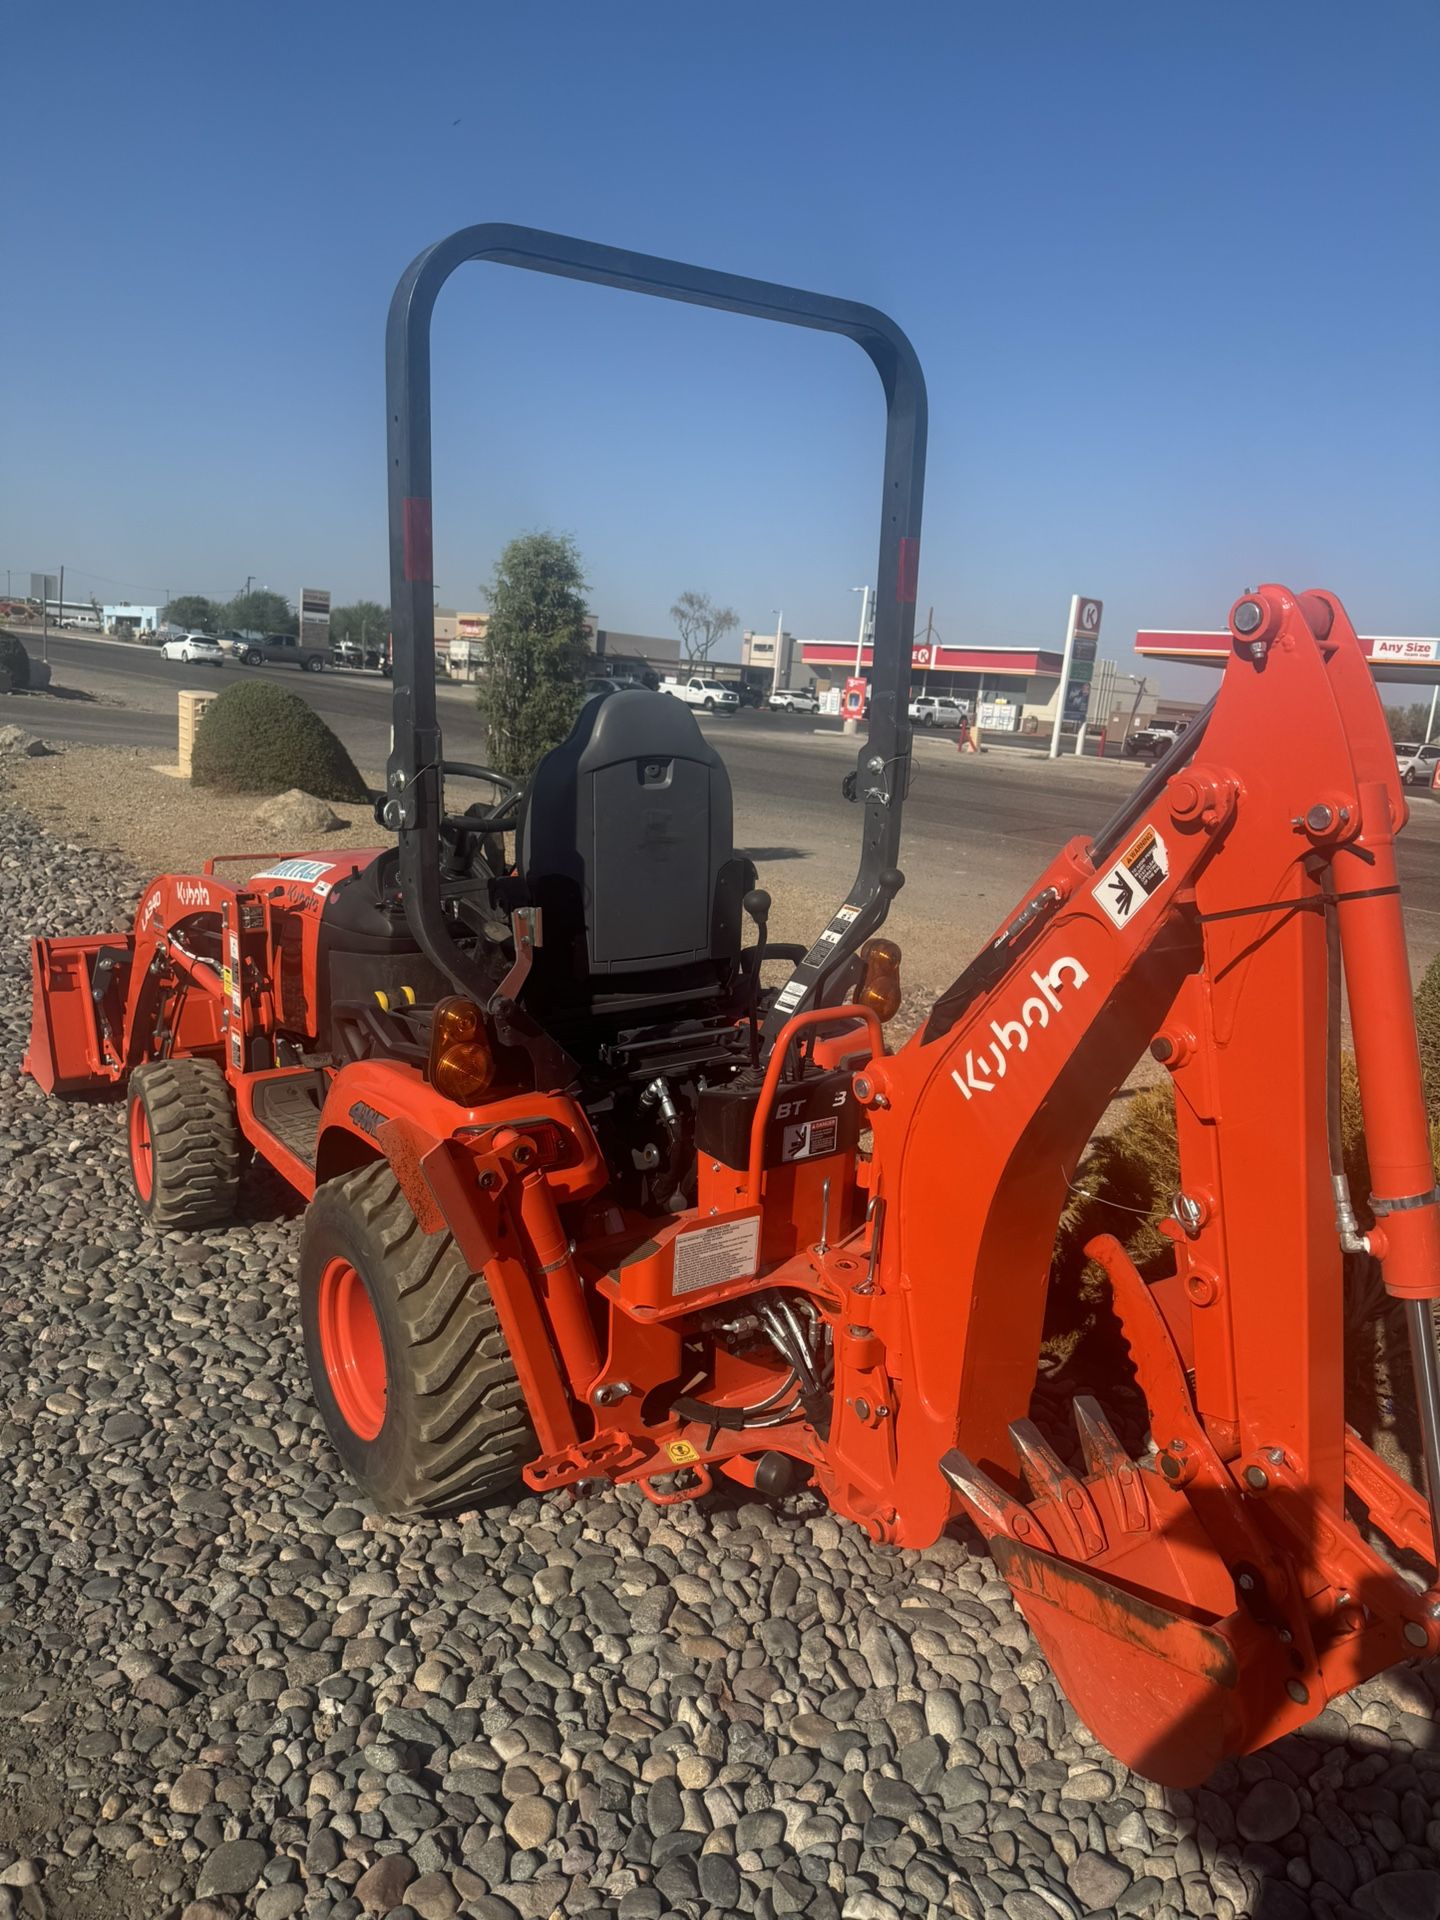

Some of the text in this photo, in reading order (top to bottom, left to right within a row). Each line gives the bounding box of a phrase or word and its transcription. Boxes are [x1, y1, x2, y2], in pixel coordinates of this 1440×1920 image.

[1380, 642, 1431, 653] Any Size
[1128, 830, 1153, 859] WARNING
[176, 881, 210, 906] Kubota
[287, 884, 319, 913] Kubota
[951, 956, 1090, 1101] Kubota
